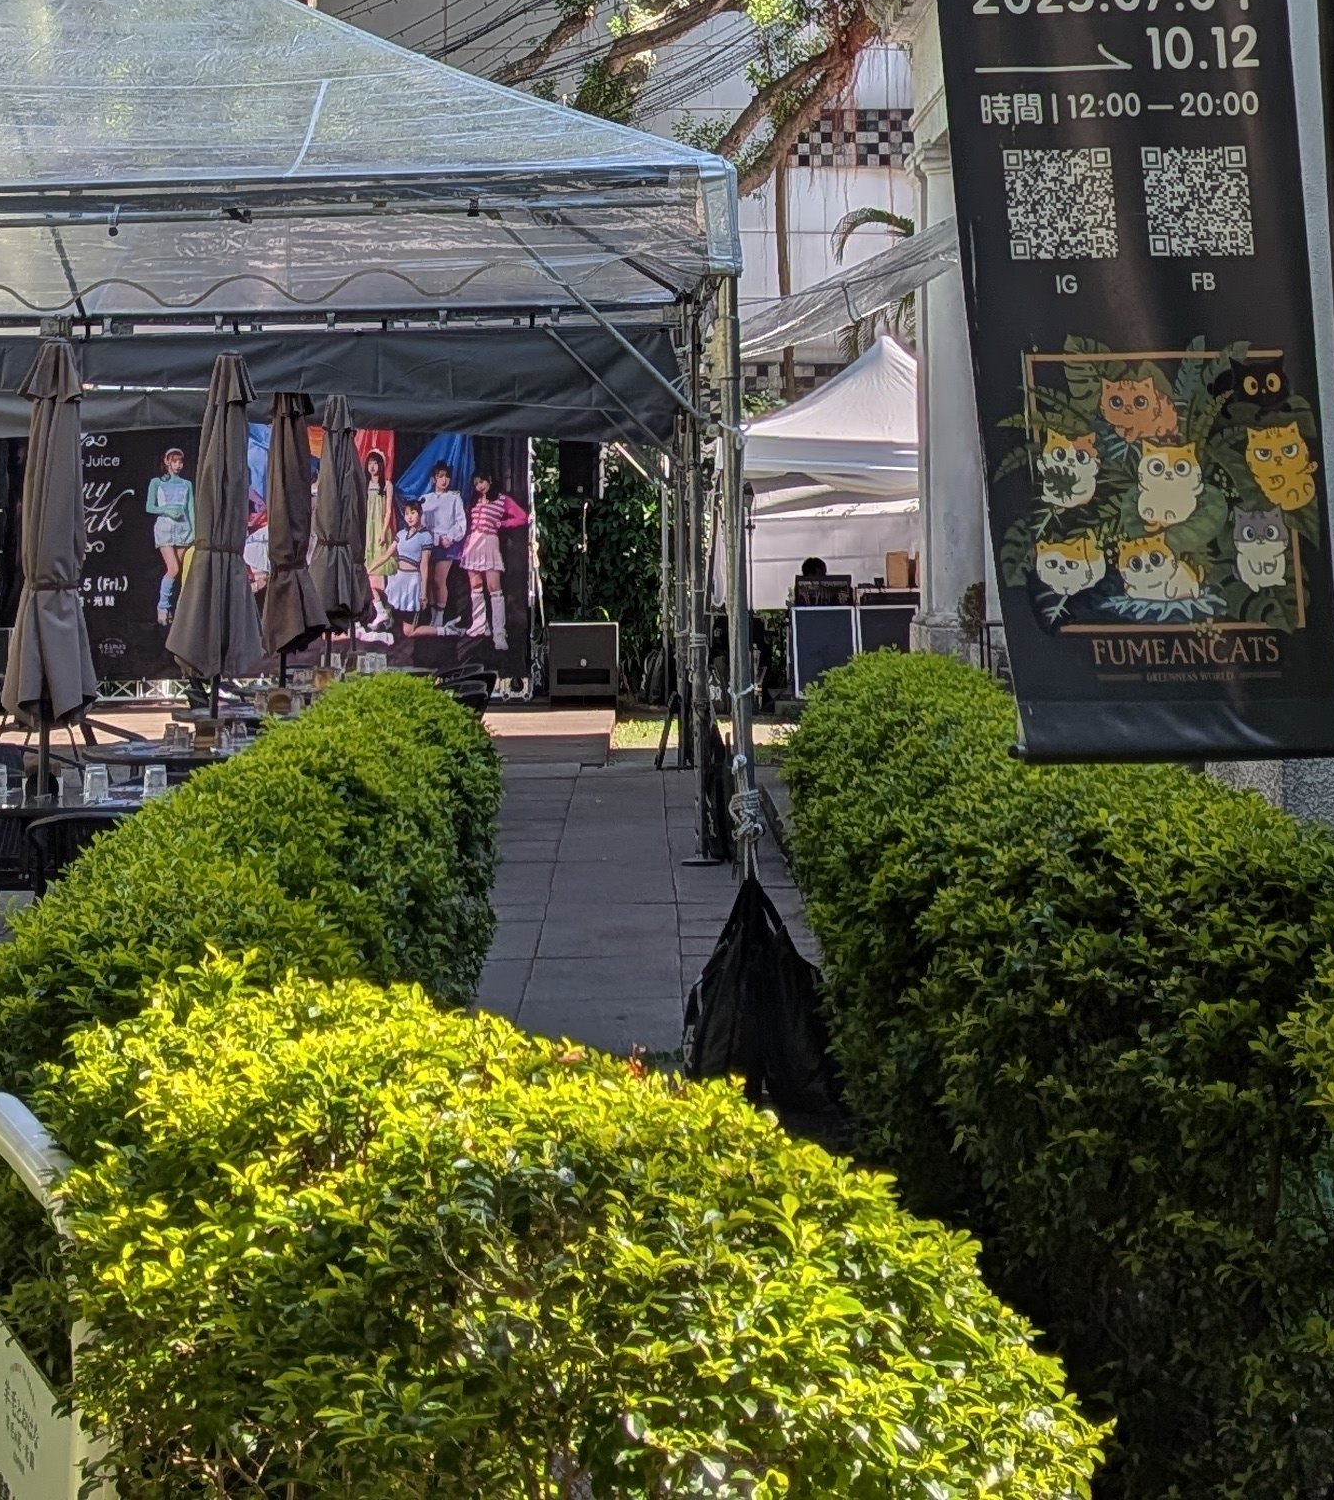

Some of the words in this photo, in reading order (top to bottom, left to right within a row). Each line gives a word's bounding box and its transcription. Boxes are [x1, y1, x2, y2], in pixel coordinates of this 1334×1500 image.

[1146, 25, 1260, 70] 10.12
[1055, 274, 1078, 294] IG
[1191, 272, 1216, 292] FB
[1092, 636, 1279, 665] FUMEANCATS
